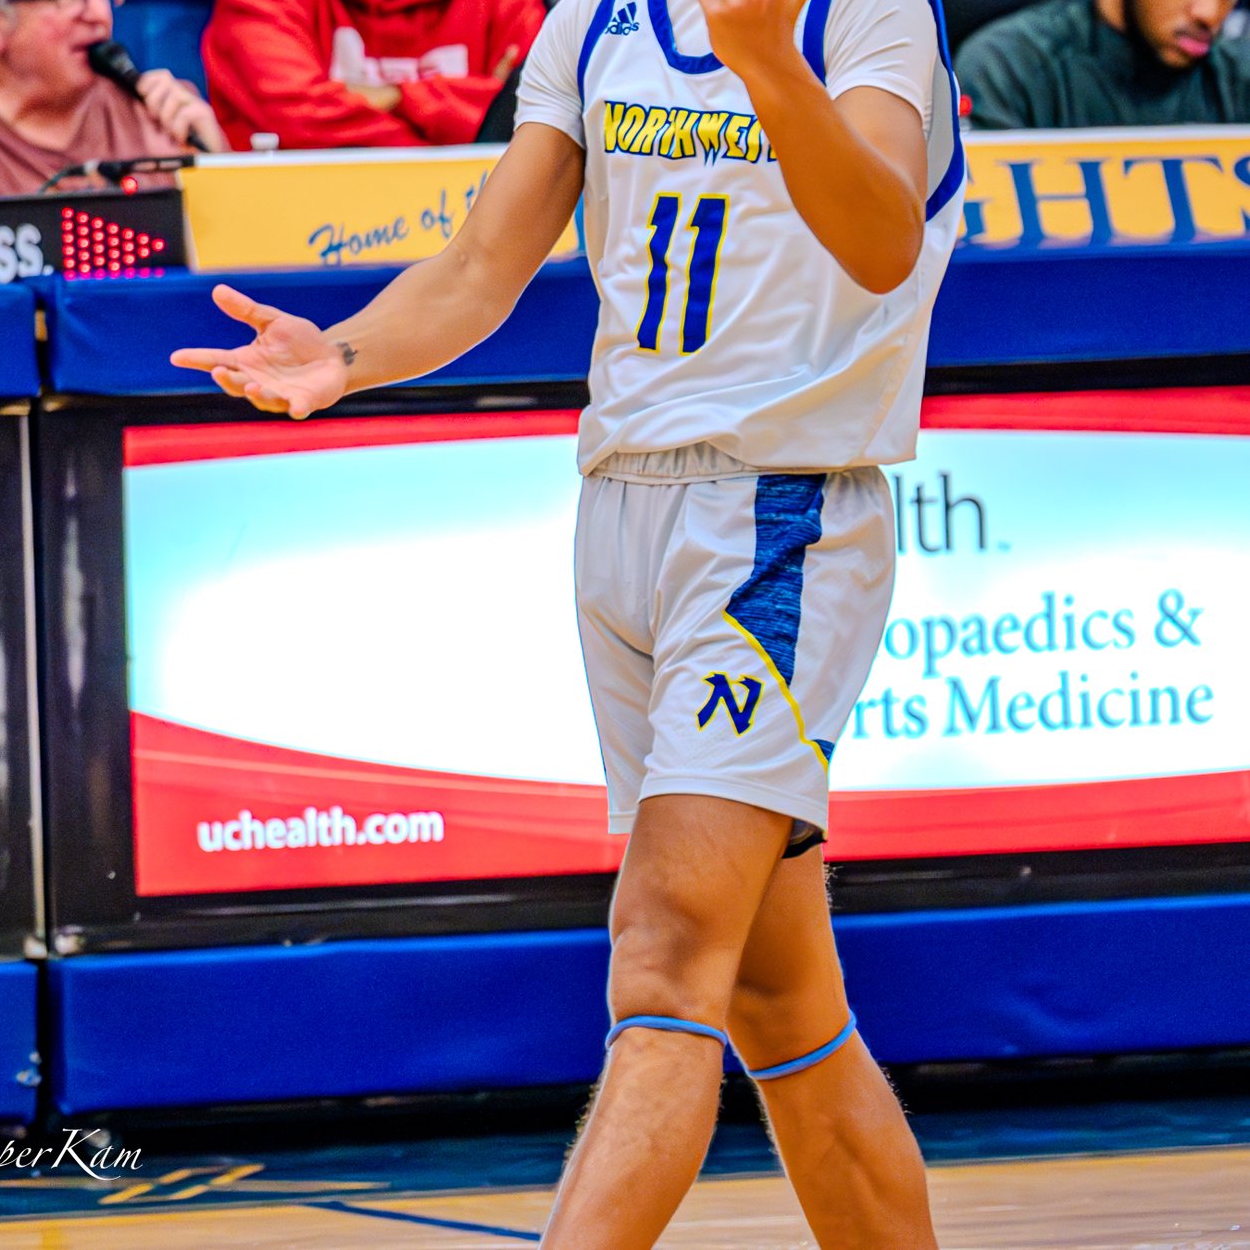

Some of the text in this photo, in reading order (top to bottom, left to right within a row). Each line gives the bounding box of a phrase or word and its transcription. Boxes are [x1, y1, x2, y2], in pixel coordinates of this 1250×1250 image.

[308, 215, 408, 267] Home
[421, 188, 454, 239] of
[634, 192, 731, 357] 11
[1153, 587, 1205, 649] &
[941, 670, 1215, 736] Medicine
[196, 805, 445, 852] uchealth.com
